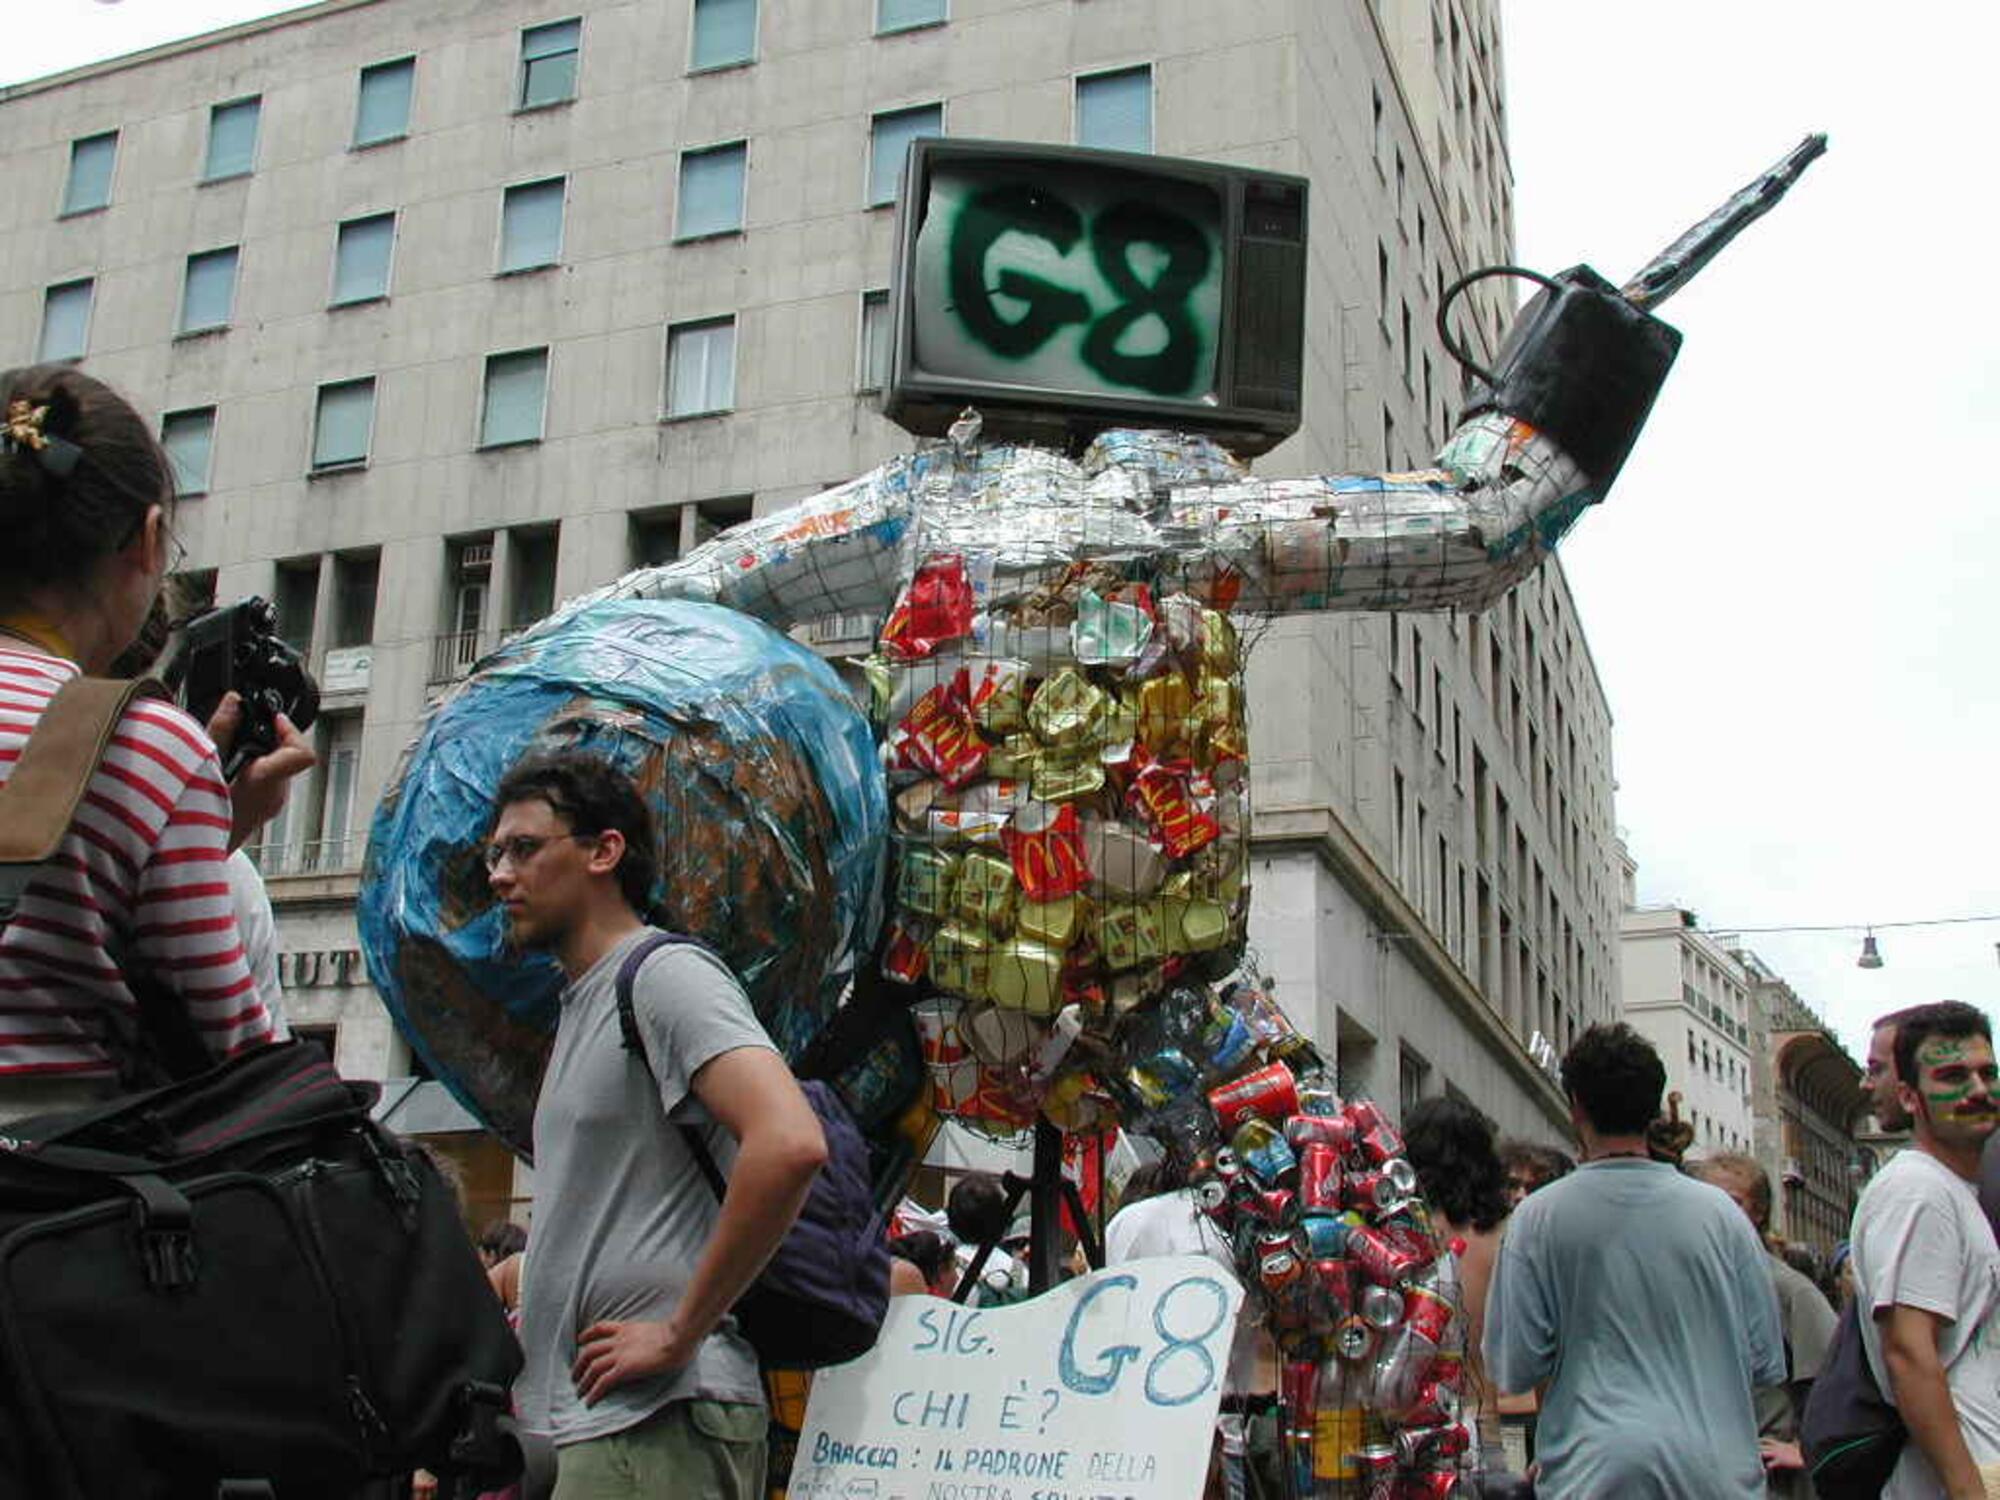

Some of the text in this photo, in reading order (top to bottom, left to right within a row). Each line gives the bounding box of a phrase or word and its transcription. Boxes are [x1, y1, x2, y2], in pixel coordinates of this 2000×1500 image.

[950, 186, 1211, 397] G8
[914, 1274, 1228, 1406] SIG. G8
[893, 1390, 970, 1430] CHI
[963, 1448, 1070, 1479] PADRONE
[1087, 1452, 1157, 1483] DELLA
